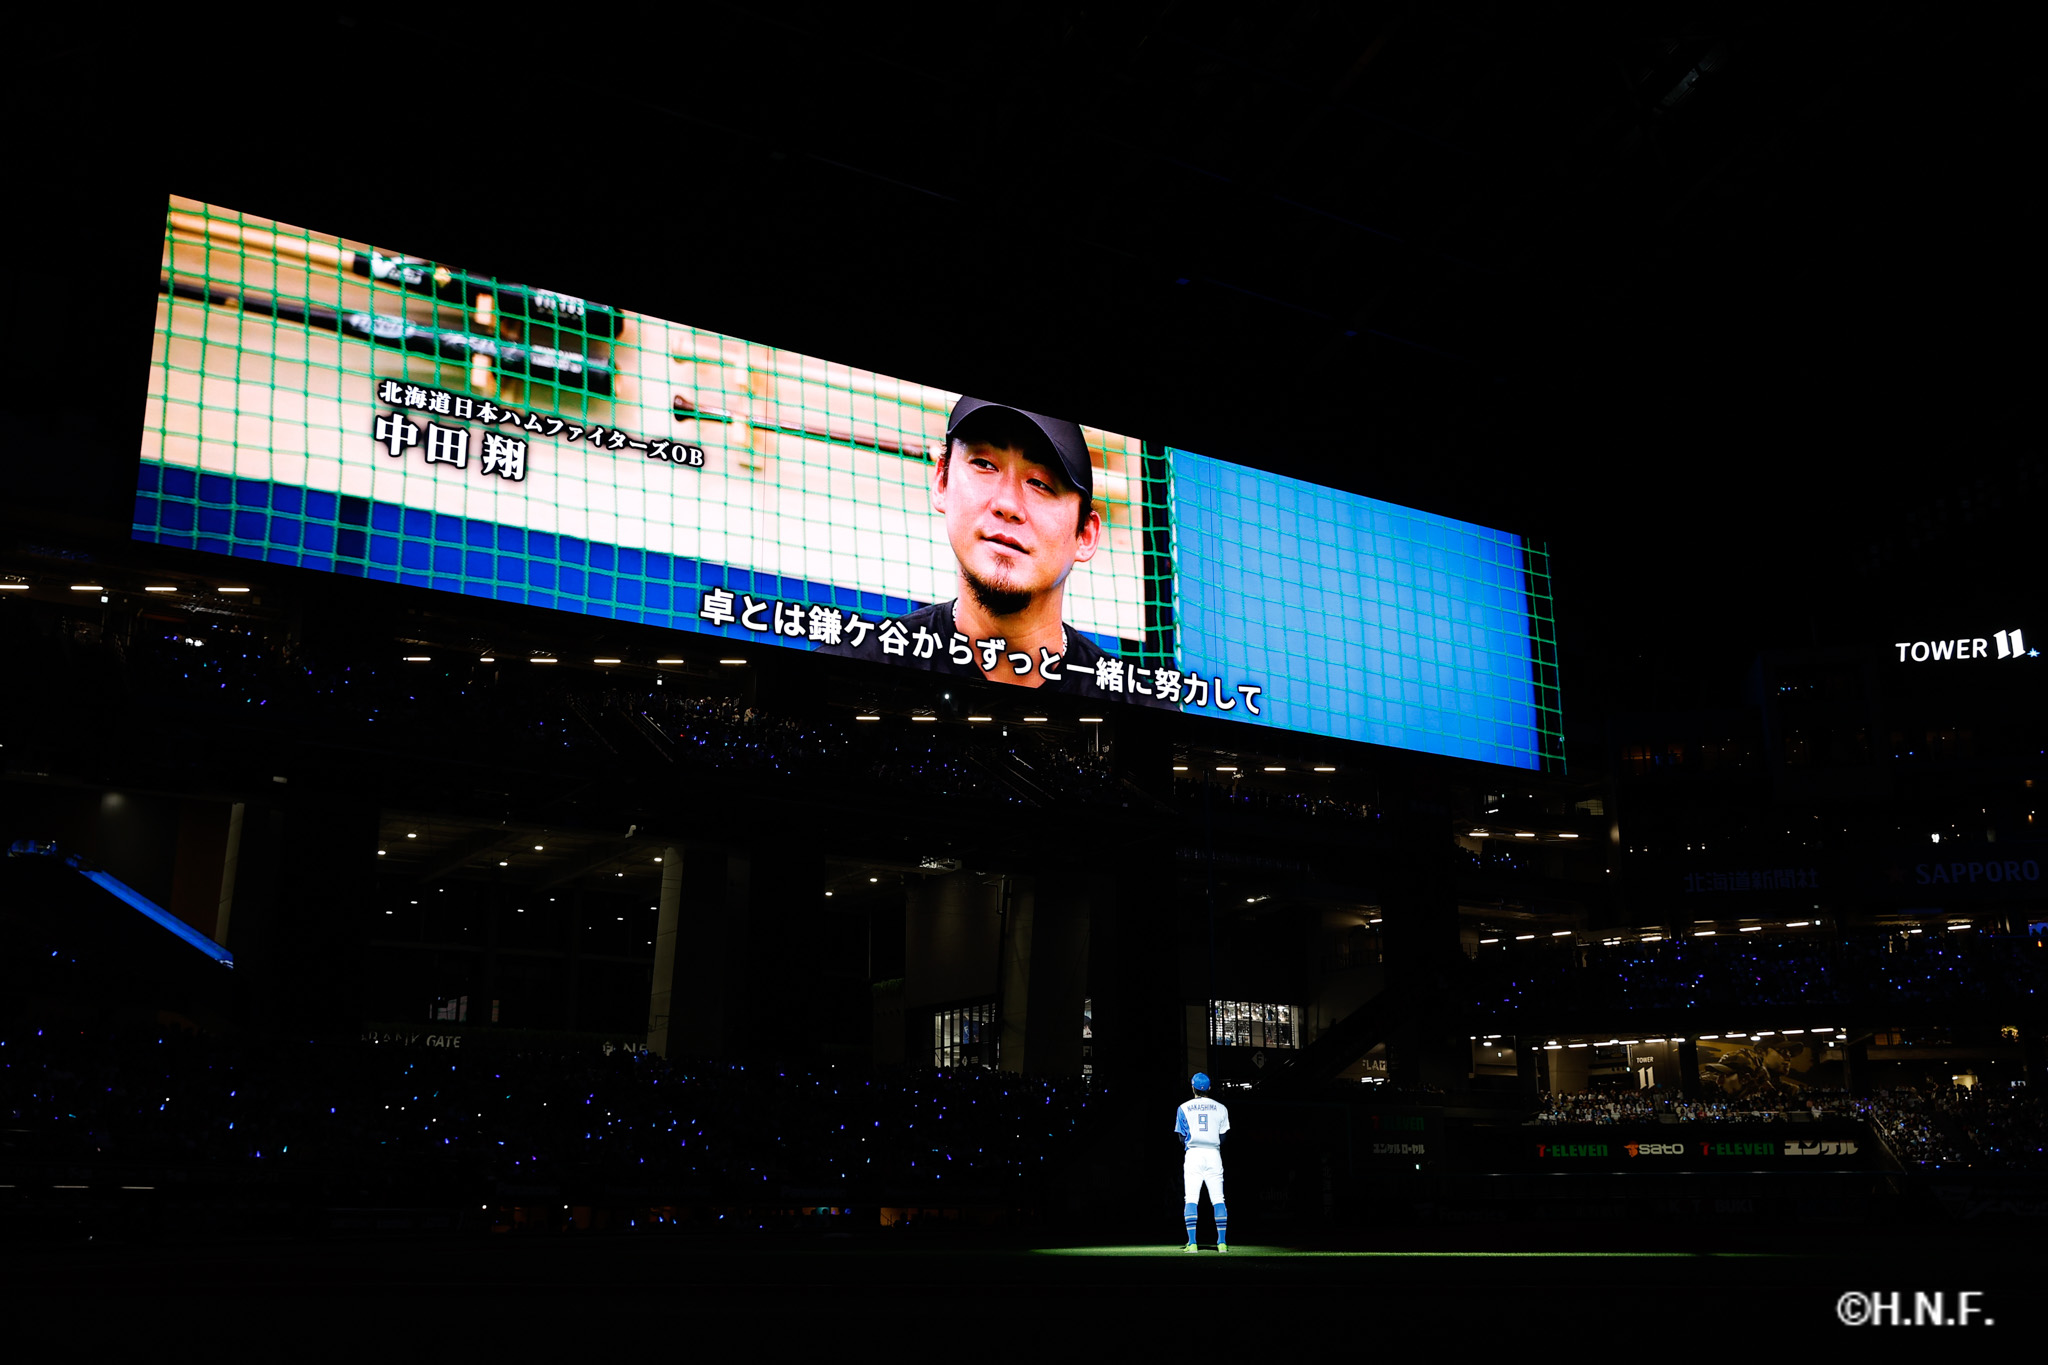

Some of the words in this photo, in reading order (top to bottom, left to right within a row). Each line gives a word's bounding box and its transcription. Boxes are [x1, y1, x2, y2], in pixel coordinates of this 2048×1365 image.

[379, 380, 705, 467] 北海道日本ハムファイターズOB
[699, 587, 1262, 715] 卓とは鎌ケ谷からずっと一緒に努力して
[1895, 638, 1988, 663] TOWER
[1993, 628, 2026, 660] 11
[1683, 867, 1820, 893] 北海道新聞社
[1915, 859, 2040, 885] SAPPORO
[426, 1034, 462, 1049] GATE
[1636, 1056, 1654, 1064] TOWER
[1638, 1066, 1655, 1090] 11
[1187, 1103, 1218, 1112] NAKASHIMA
[1198, 1113, 1209, 1132] 9
[1370, 1114, 1425, 1132] 7ELEVEN
[1536, 1144, 1608, 1158] 7-ELEVEN
[1700, 1142, 1775, 1156] 7-ELEVEN
[1784, 1139, 1860, 1156] ユンケル
